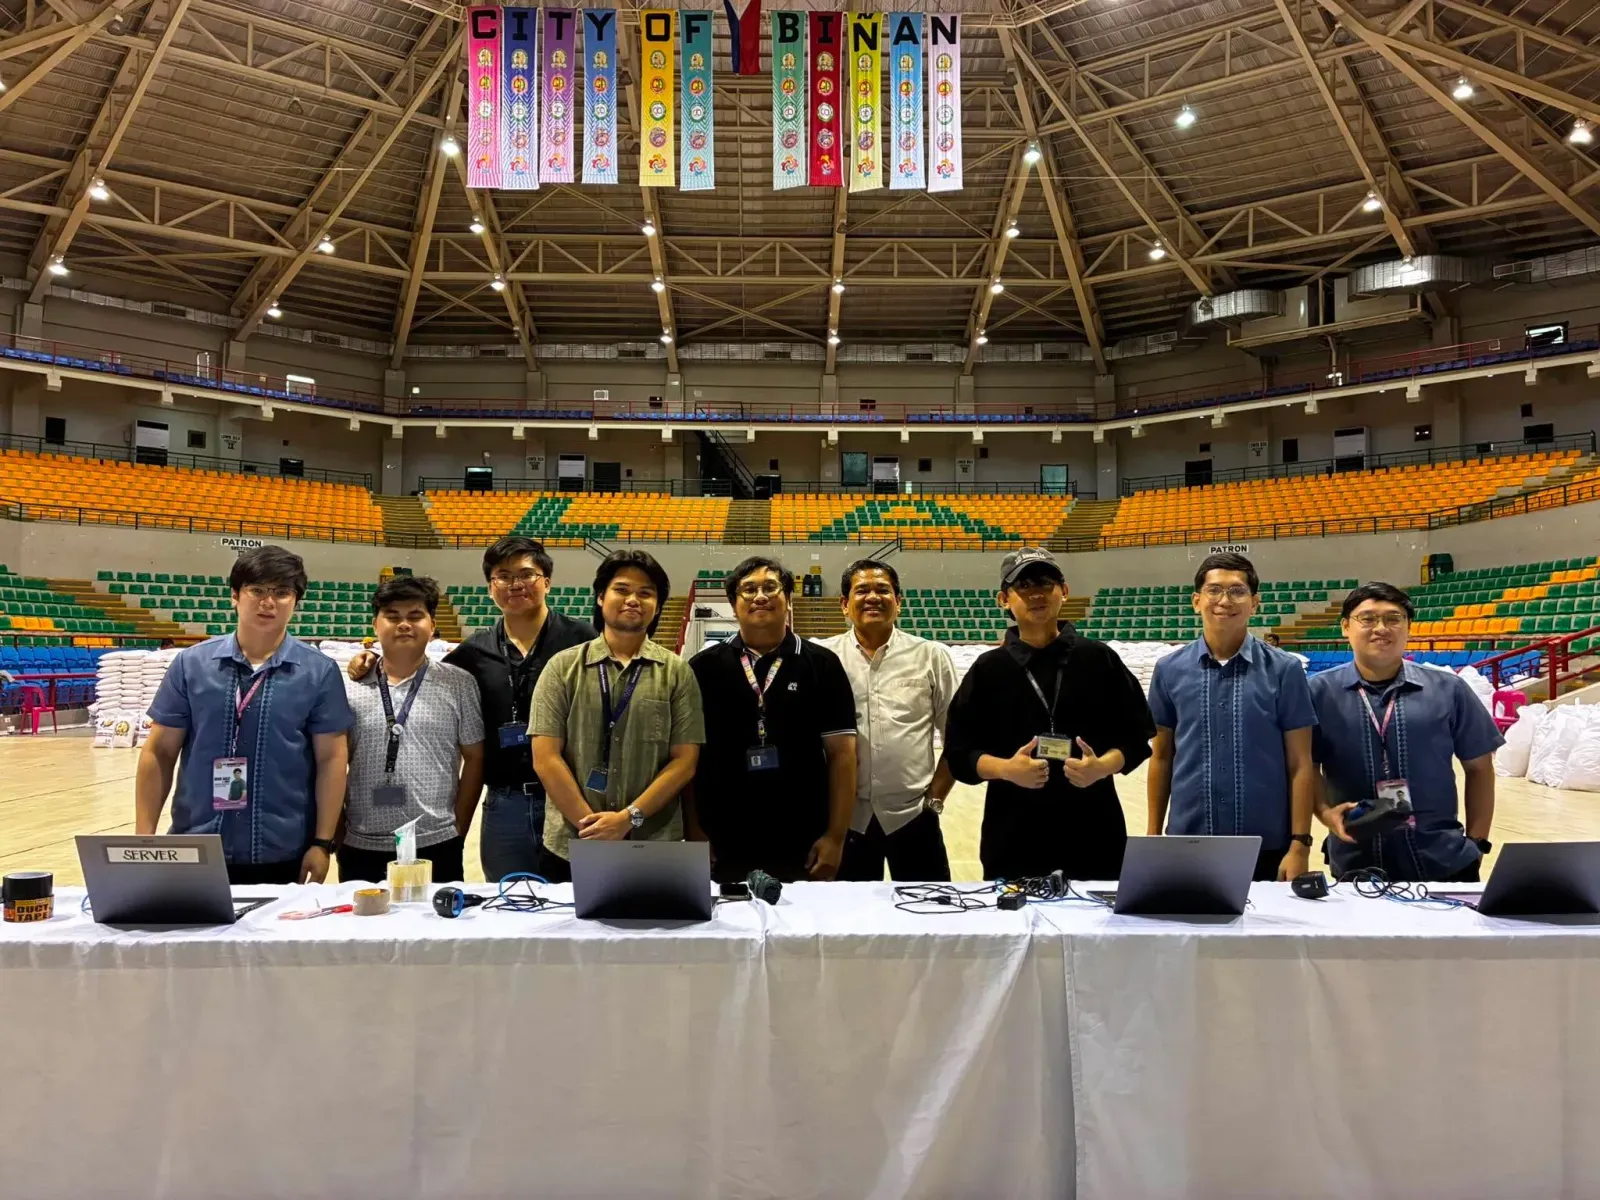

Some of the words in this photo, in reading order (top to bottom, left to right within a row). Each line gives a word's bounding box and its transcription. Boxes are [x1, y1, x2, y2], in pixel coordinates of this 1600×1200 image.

[472, 10, 615, 41] CITY
[645, 13, 708, 43] OF
[777, 12, 957, 52] BIÑAN
[222, 538, 262, 547] PATRON
[1210, 545, 1248, 553] PATRON
[123, 849, 179, 861] SERVER
[17, 903, 49, 914] DUCT
[17, 911, 49, 922] TAPE
